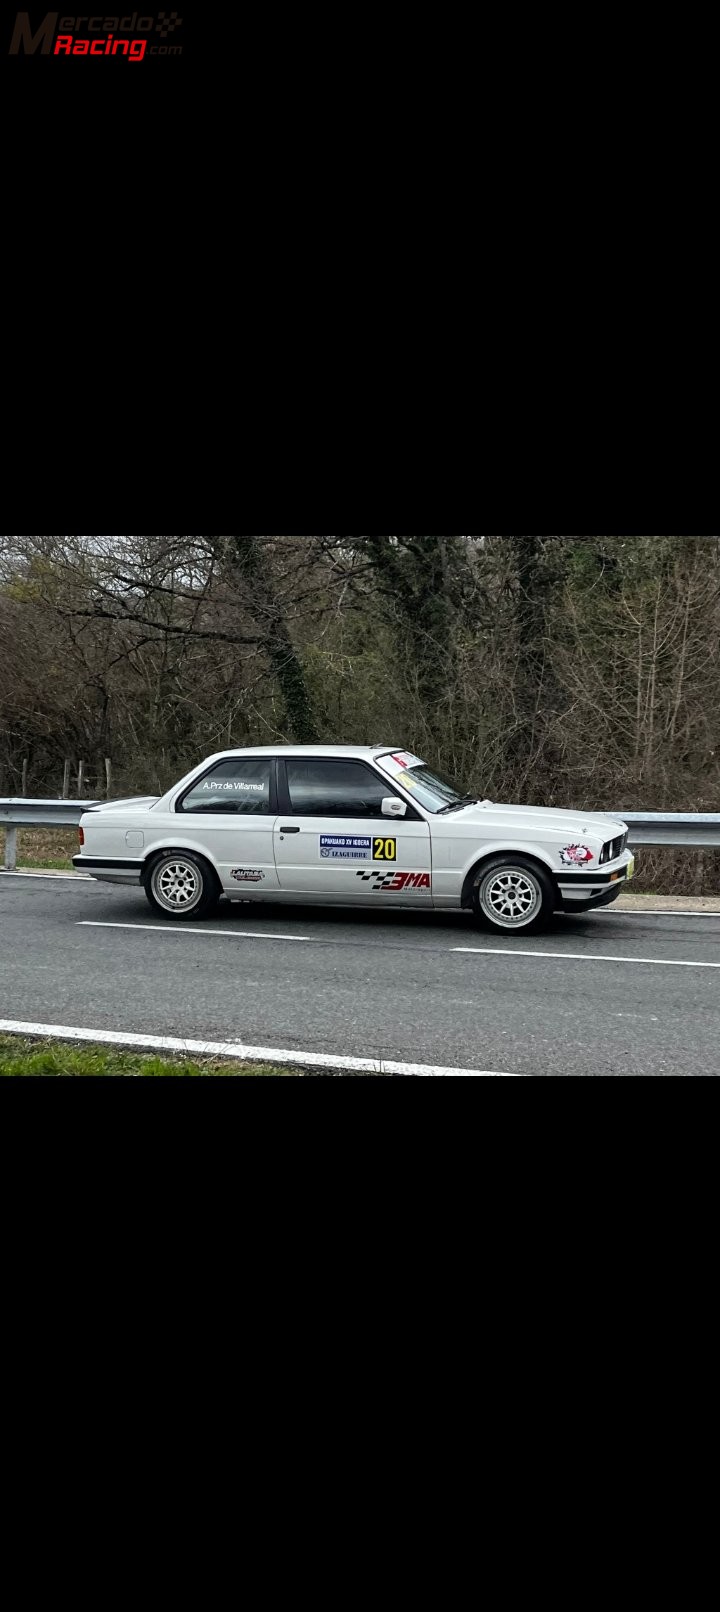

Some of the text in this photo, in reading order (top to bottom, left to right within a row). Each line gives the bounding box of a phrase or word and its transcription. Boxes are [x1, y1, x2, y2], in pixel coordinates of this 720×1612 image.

[203, 782, 265, 791] A.Prz de Villarreal
[374, 838, 395, 860] 20
